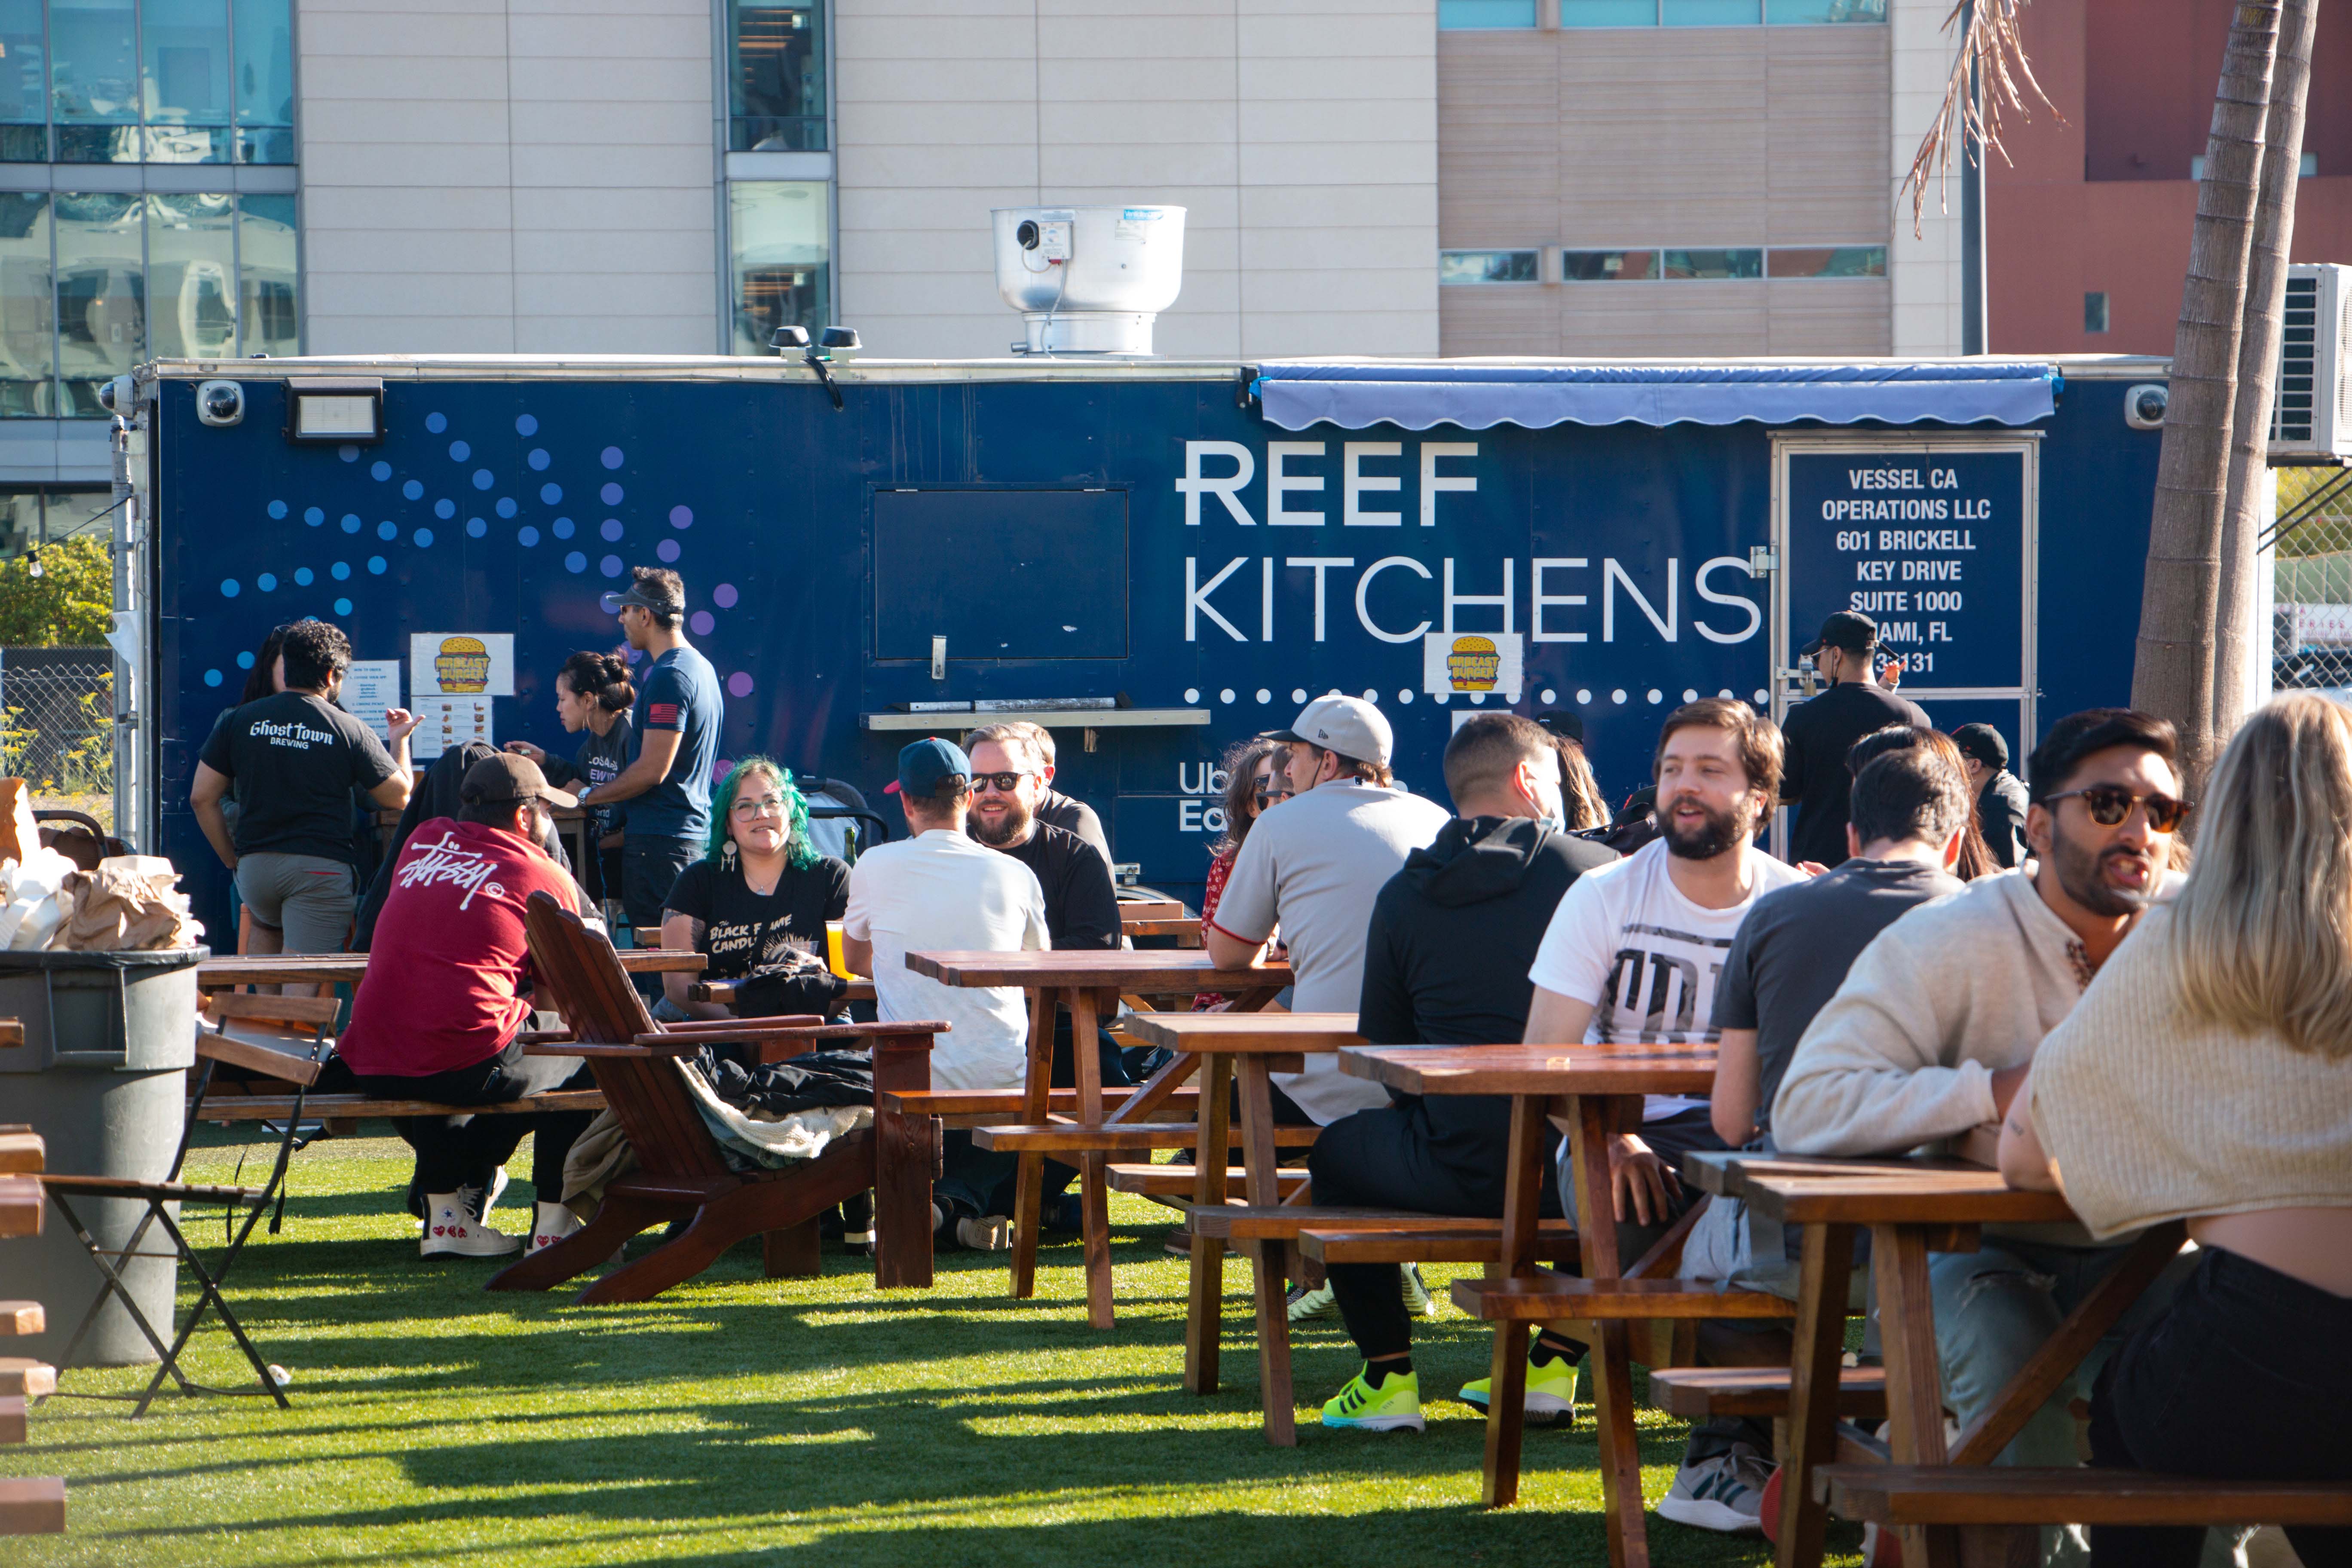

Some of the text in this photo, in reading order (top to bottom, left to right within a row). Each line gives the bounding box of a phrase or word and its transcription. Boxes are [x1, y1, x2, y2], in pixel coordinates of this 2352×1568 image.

[1176, 441, 1478, 526] REEF
[1849, 469, 1958, 489] VESSEL CA
[1822, 499, 1991, 520] OPERATIONS LLC
[1836, 530, 1976, 551] 601 BRICKELL
[1857, 560, 1962, 581] KEY DRIVE
[1185, 556, 1761, 644] KITCHENS
[1850, 591, 1962, 612] SUITE 1000
[1874, 622, 1953, 646] IAMI, FL
[1876, 652, 1933, 672] 3131
[440, 668, 485, 680] BURGER
[1452, 667, 1495, 680] BURGER
[250, 720, 294, 738] Ghost
[270, 737, 309, 750] BREWING
[1179, 762, 1229, 794] Ub
[1179, 800, 1228, 832] Ea
[709, 913, 793, 941] BLACK FAME
[711, 936, 757, 954] CANDL
